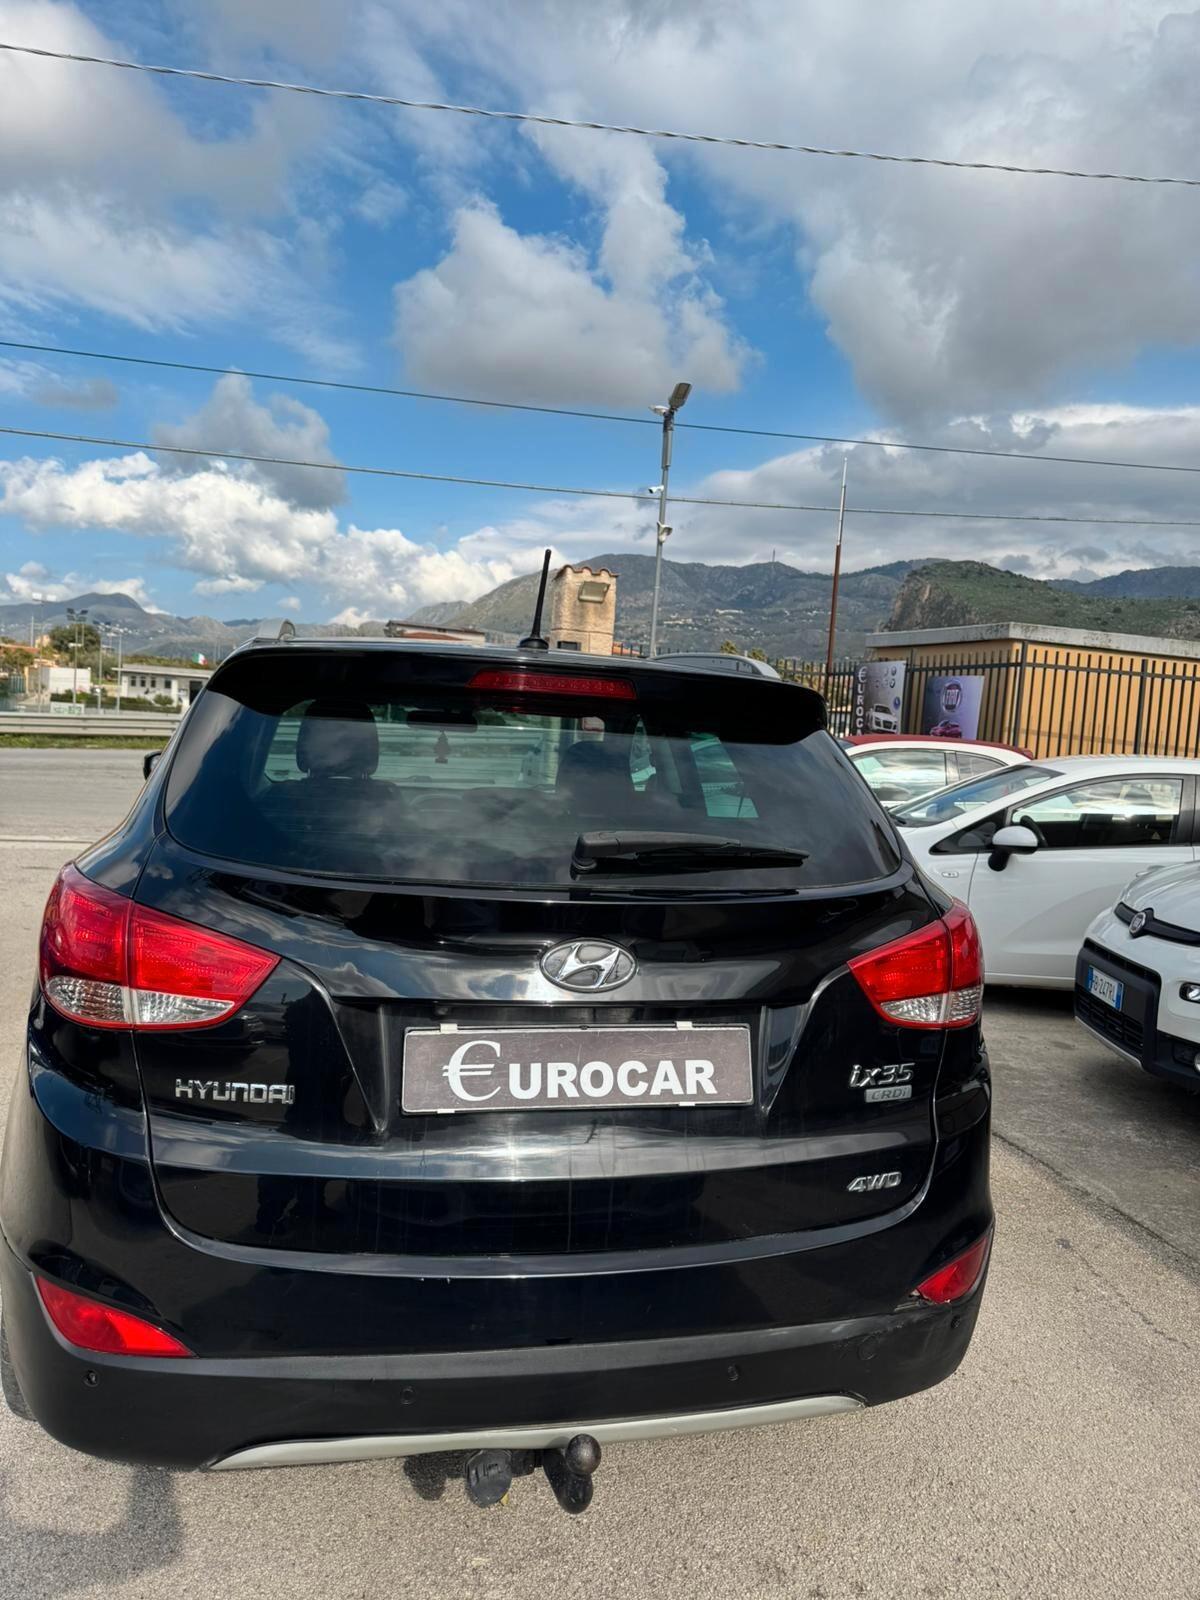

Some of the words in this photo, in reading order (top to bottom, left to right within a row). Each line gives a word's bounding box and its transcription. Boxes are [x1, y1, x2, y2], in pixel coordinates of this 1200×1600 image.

[848, 1062, 916, 1087] ix35
[175, 1078, 295, 1105] HYUNDAI
[847, 1171, 902, 1192] 4WD
